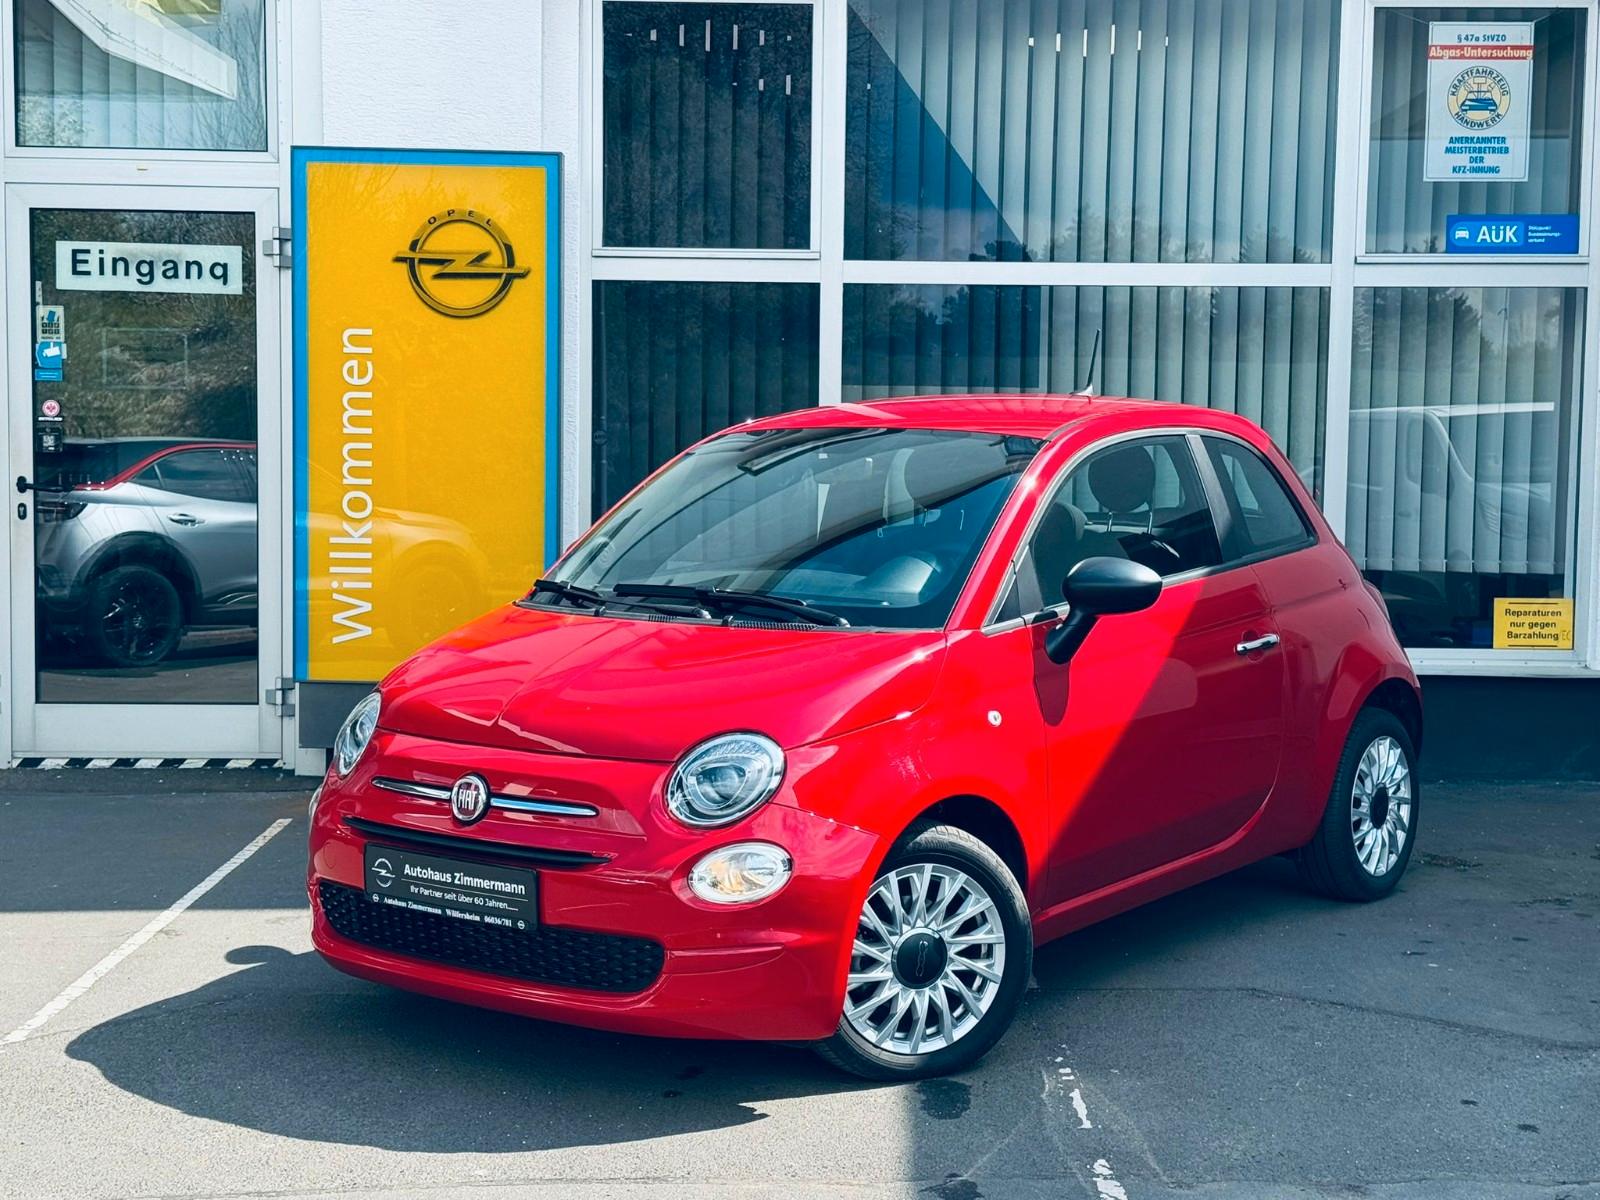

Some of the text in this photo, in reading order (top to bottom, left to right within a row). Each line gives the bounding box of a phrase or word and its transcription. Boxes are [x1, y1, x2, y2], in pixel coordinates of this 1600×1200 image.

[1464, 34, 1480, 42] 47a
[1482, 34, 1507, 43] StVZO
[1429, 46, 1533, 60] Abgas-Untersuchung
[1450, 68, 1509, 97] KRAFTFAHRZEUG
[1454, 111, 1502, 128] HANDWERK
[1448, 136, 1507, 145] ANERKANNTER
[1444, 146, 1510, 155] MEISTERBETRIEB
[1469, 156, 1484, 164] DER
[1452, 166, 1501, 174] KFZ-INNUNG
[427, 209, 492, 227] OPEL
[1476, 225, 1518, 243] AÜK
[329, 327, 374, 644] Willkommen
[1504, 608, 1562, 618] Reparaturen
[1527, 621, 1557, 630] gegen
[1506, 631, 1559, 641] Barzahlung
[457, 788, 478, 810] FIAT
[403, 863, 526, 896] Autohaus Zimmermann
[410, 885, 419, 893] Ihr
[419, 886, 444, 899] Partner
[443, 891, 457, 901] seit
[457, 893, 473, 904] über
[474, 896, 484, 906] 60
